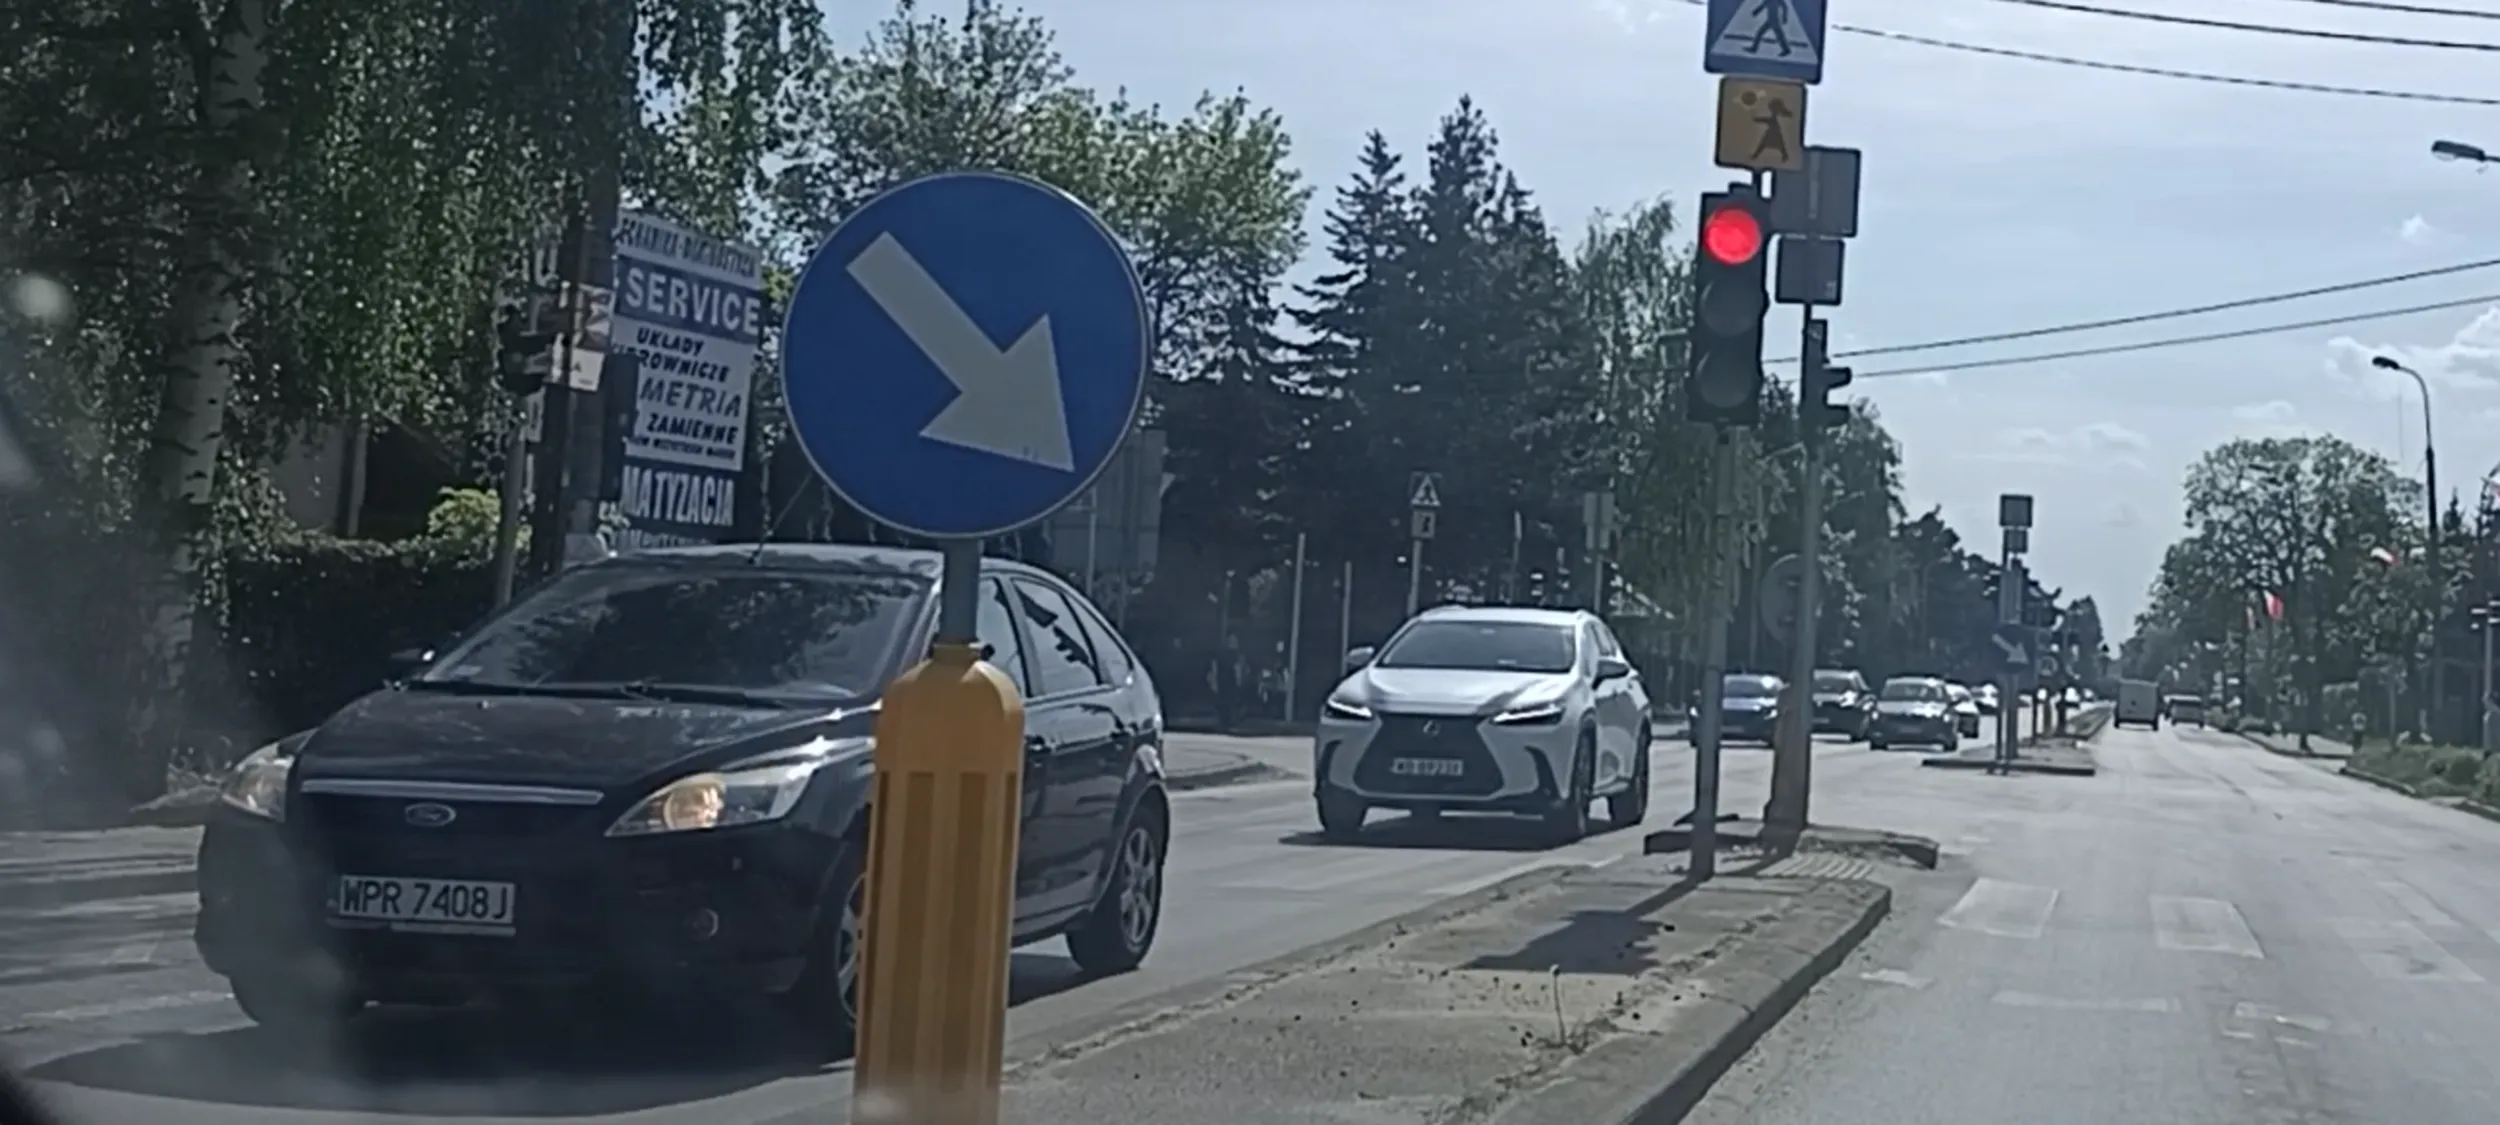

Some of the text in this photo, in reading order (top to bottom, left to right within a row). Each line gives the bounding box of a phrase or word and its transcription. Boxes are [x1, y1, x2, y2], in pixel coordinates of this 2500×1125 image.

[624, 267, 761, 337] SERVICE
[612, 343, 730, 382] ROWNICZE
[646, 412, 739, 445] ZAMIENNE
[342, 880, 508, 920] WPR 7408J
